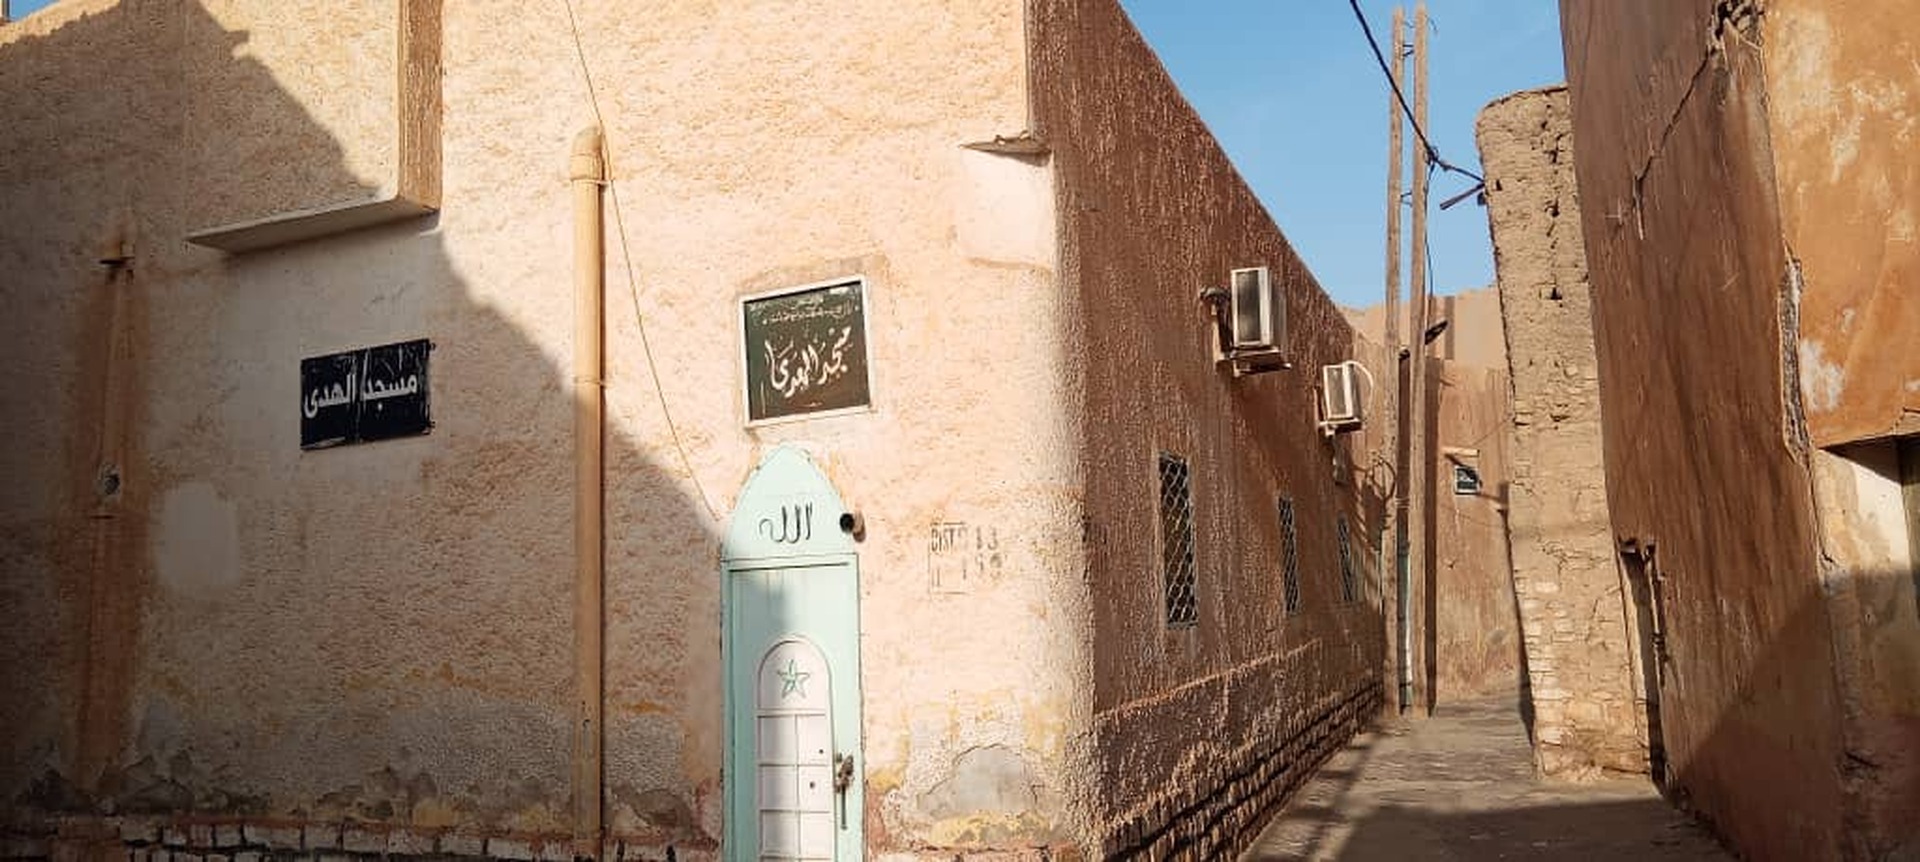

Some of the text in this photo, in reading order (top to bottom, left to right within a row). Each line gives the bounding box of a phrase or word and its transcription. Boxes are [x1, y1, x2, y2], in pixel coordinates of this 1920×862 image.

[303, 372, 418, 419] مسجد الهدى
[758, 501, 812, 544] الله
